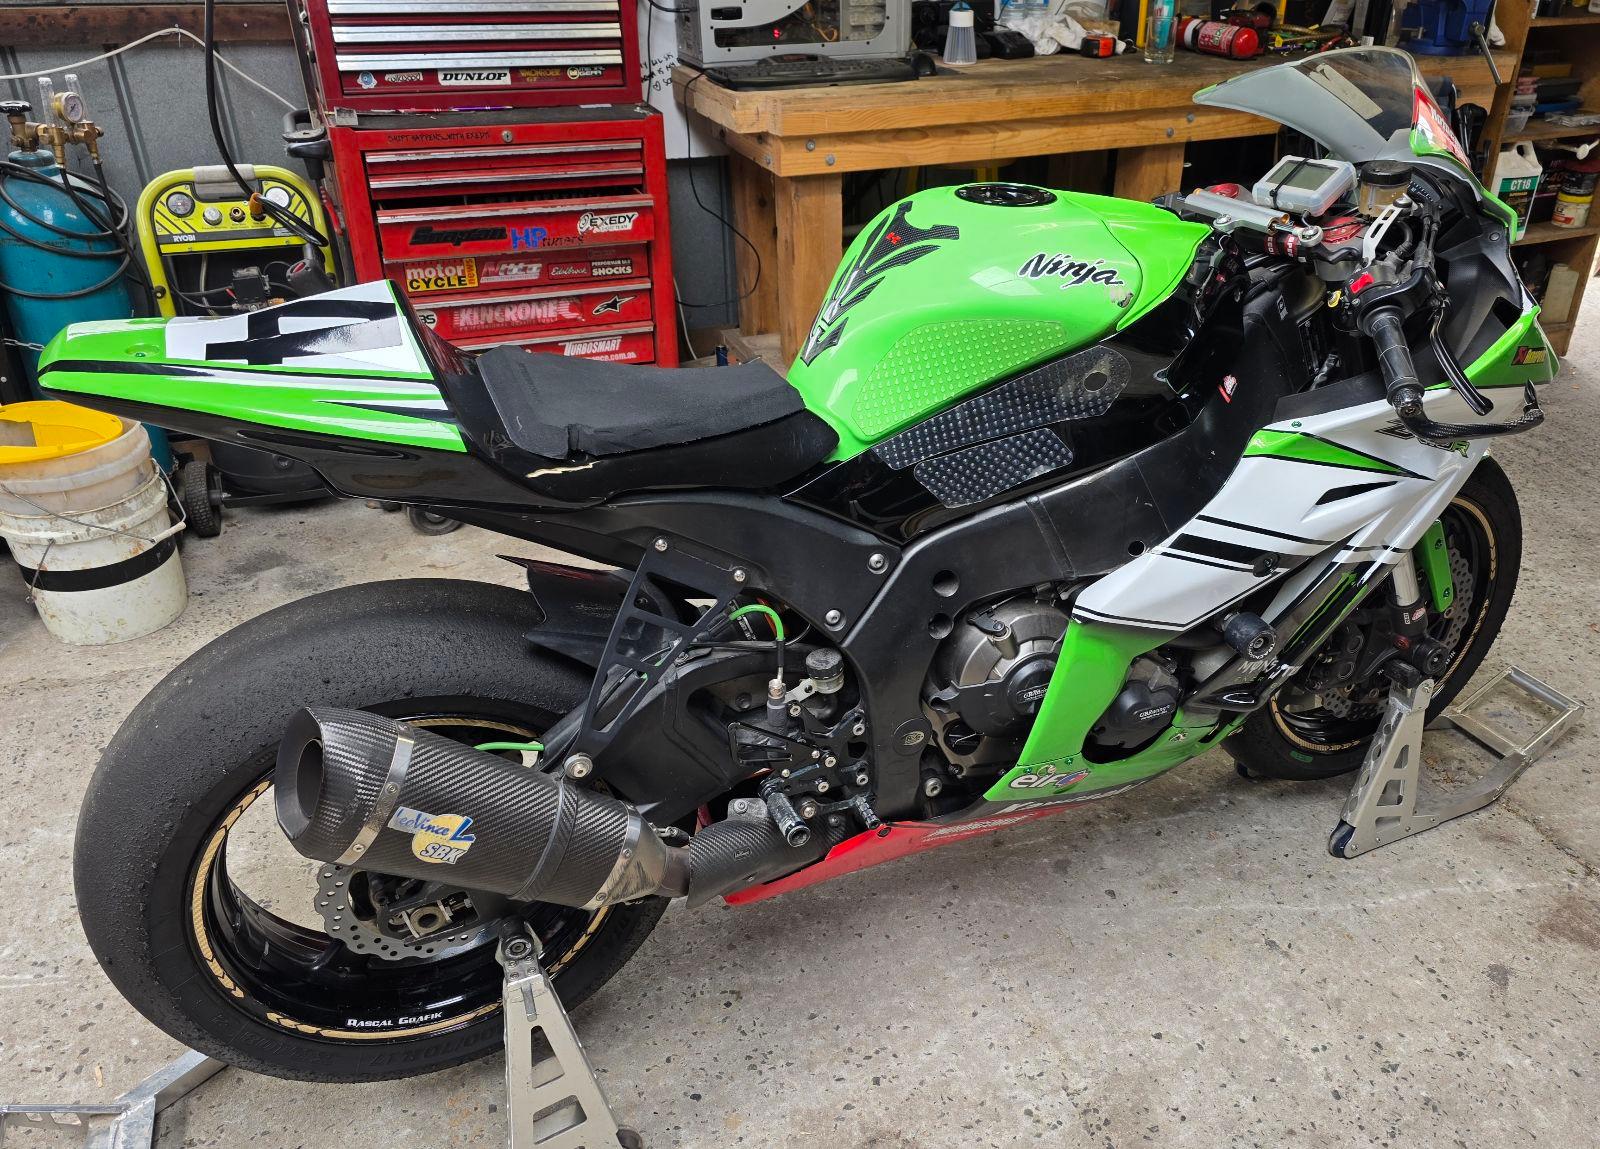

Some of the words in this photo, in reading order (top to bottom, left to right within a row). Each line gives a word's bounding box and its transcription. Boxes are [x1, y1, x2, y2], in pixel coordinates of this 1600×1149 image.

[442, 72, 507, 81] DUNLOP
[1510, 179, 1531, 190] CT18
[590, 214, 635, 226] EXEDY
[511, 227, 546, 250] HP
[406, 263, 464, 280] motor
[465, 258, 476, 285] news
[551, 266, 587, 276] Edelbrock
[592, 265, 632, 277] SHOCKS
[1018, 253, 1124, 288] Ninja
[409, 275, 467, 290] CYCLE
[459, 300, 558, 327] KINCROME
[559, 336, 622, 356] TURBOSMART
[1010, 772, 1067, 789] elf
[396, 808, 450, 836] LeoVince
[420, 842, 467, 864] SBK
[346, 1018, 394, 1028] RASCAL
[398, 1011, 443, 1025] GRAFIK
